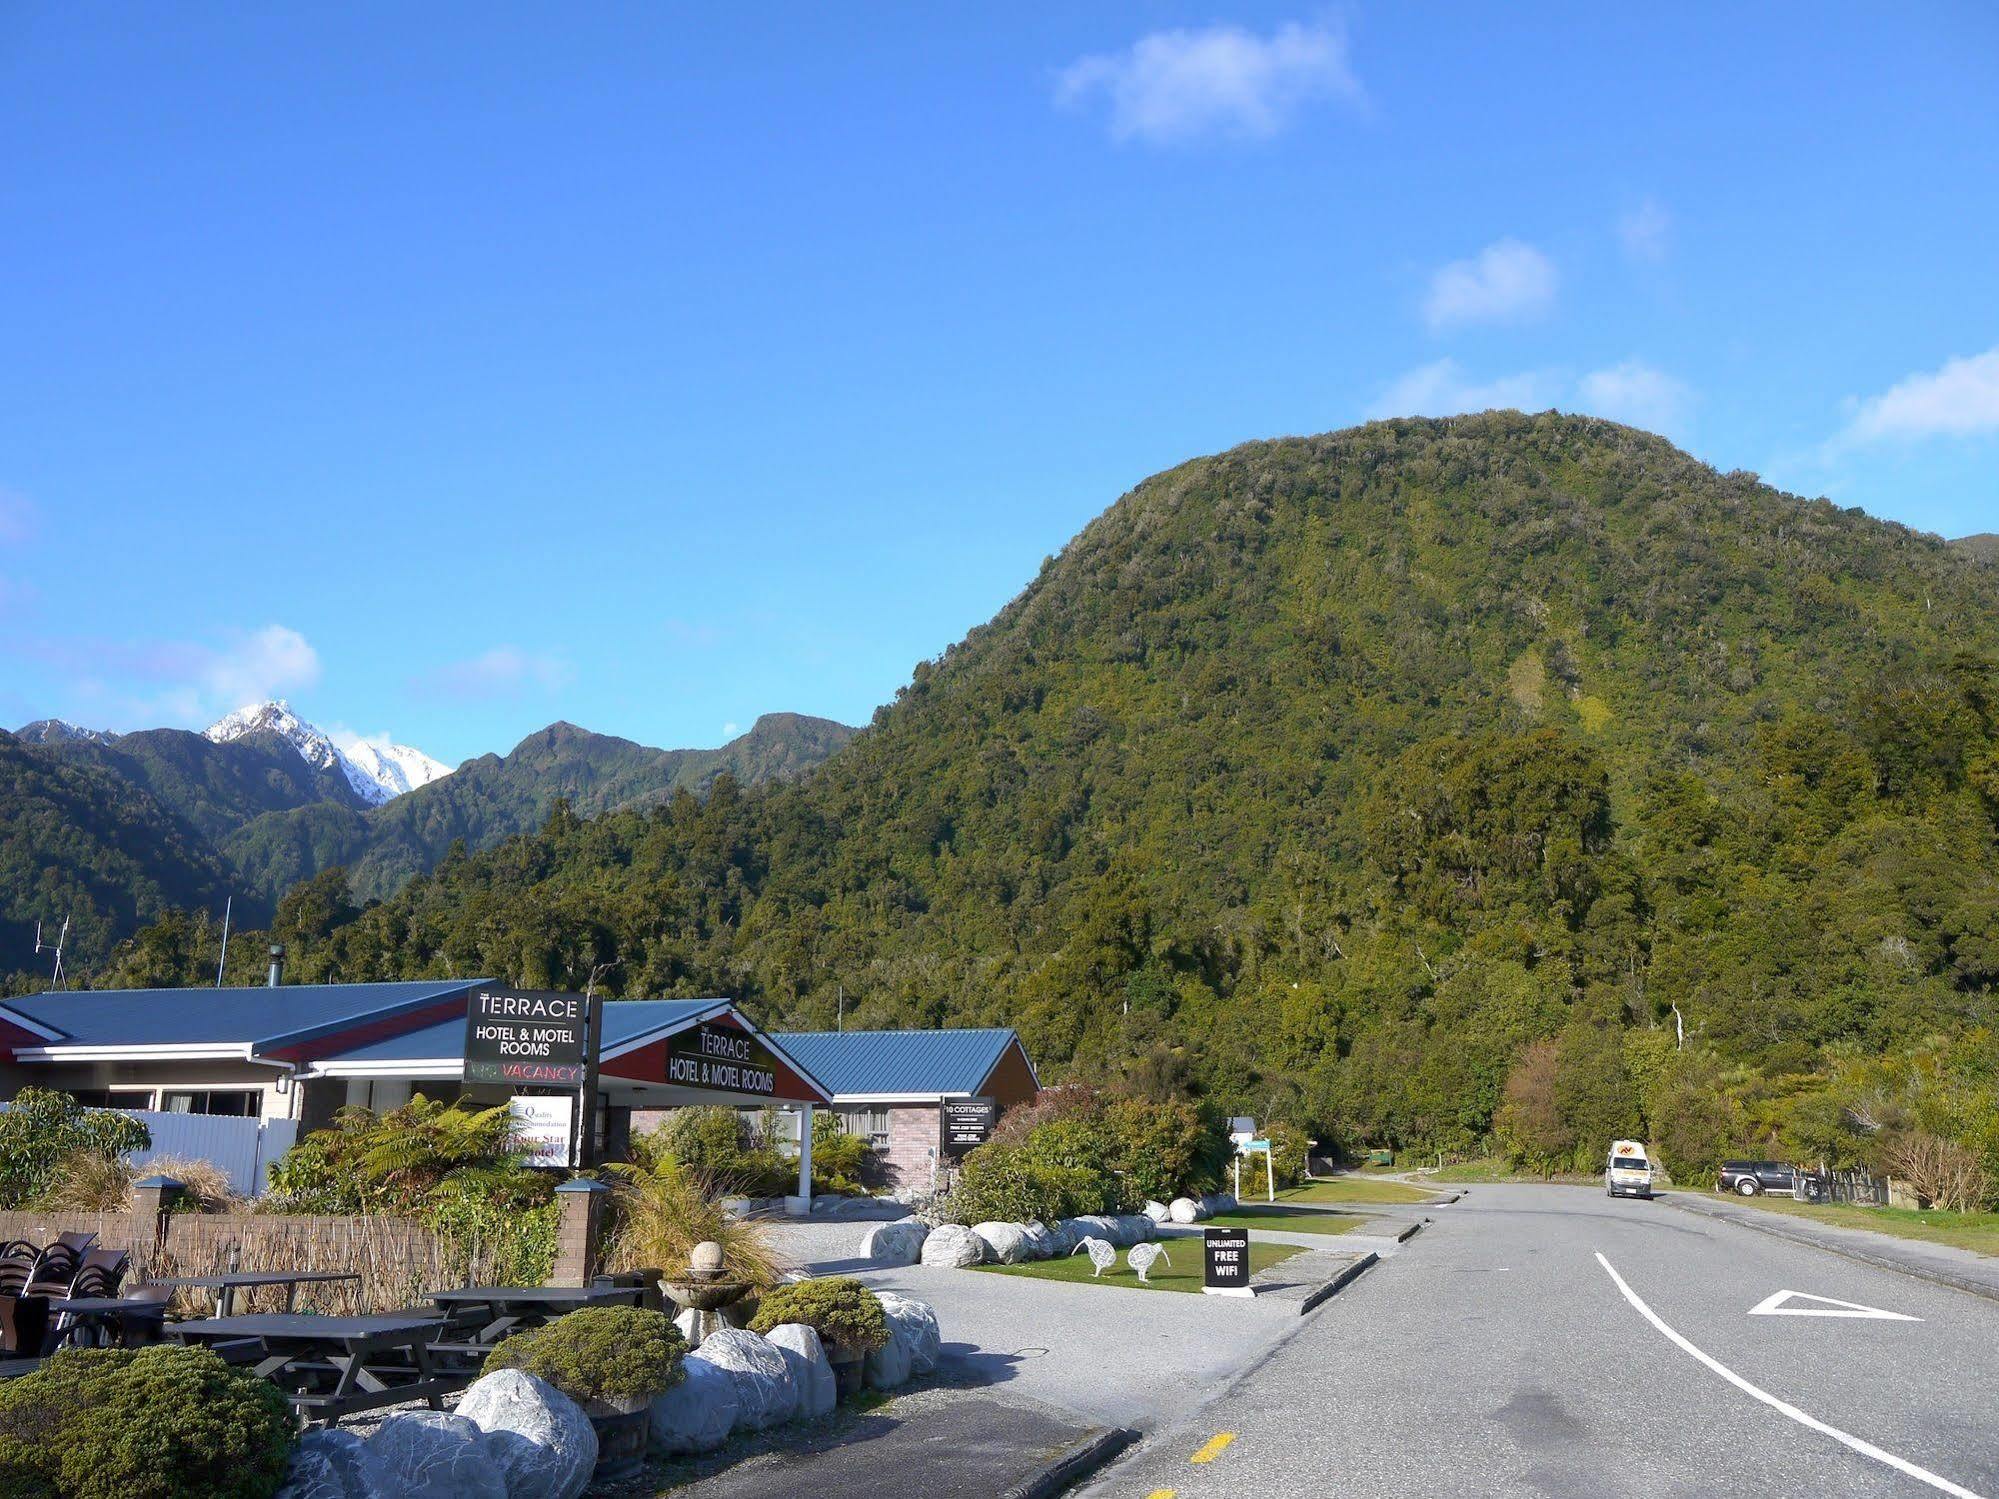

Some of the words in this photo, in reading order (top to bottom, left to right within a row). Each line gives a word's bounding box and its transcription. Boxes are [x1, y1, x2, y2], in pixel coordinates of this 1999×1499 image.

[479, 996, 578, 1018] TERRACE
[476, 1025, 516, 1041] HOTEL
[519, 1027, 530, 1041] &
[533, 1028, 575, 1043] MOTEL
[500, 1041, 550, 1057] ROOMS
[701, 1032, 750, 1060] TERRACE
[502, 1063, 578, 1080] VACANCY
[670, 1057, 700, 1082] HOTEL
[702, 1063, 710, 1084] &
[711, 1064, 740, 1088] MOTEL
[742, 1069, 774, 1093] ROOMS
[954, 1106, 989, 1114] COTTAGES
[543, 1134, 566, 1143] Star
[1206, 1239, 1246, 1248] UNLIMITED
[1214, 1251, 1239, 1262] FREE
